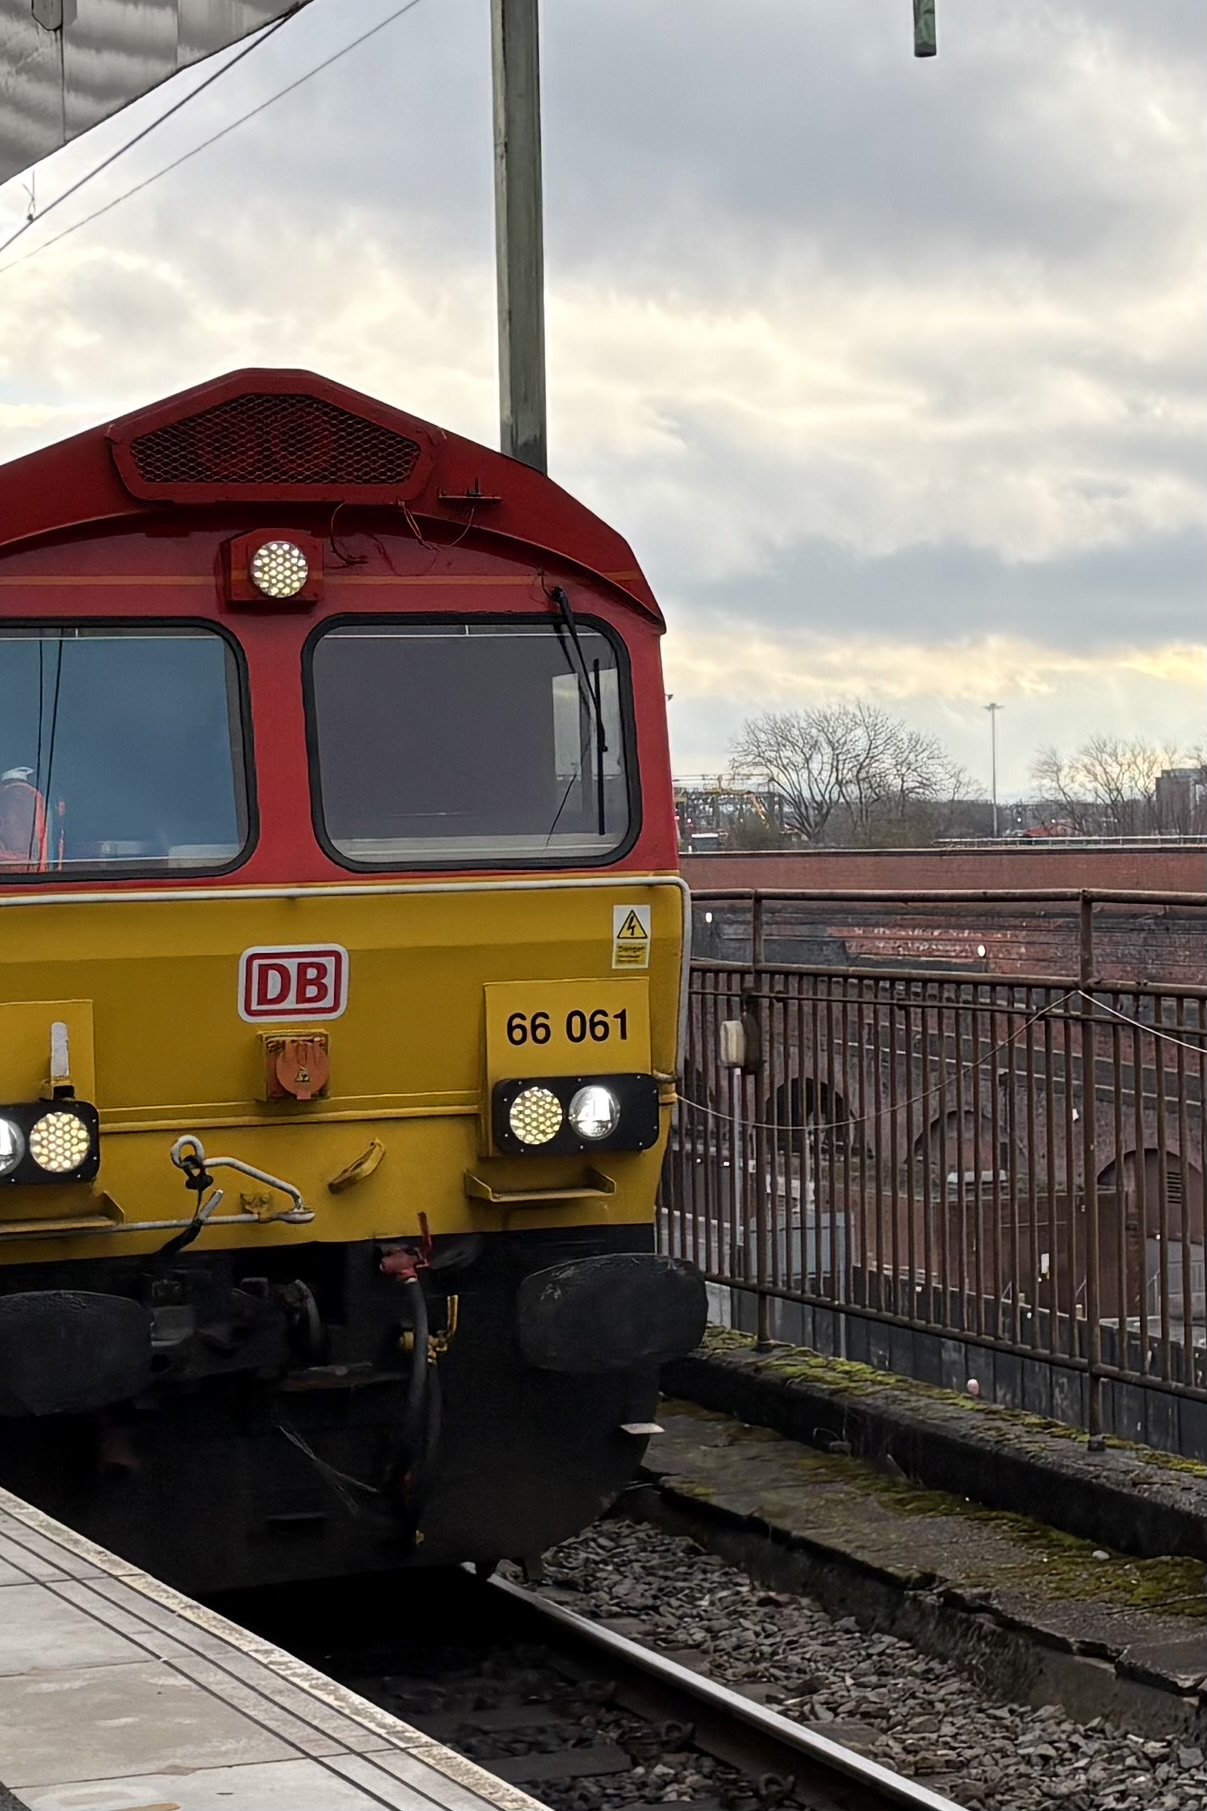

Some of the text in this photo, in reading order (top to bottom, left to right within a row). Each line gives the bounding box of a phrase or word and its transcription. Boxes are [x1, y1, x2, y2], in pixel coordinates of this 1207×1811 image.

[256, 961, 329, 1006] DB
[506, 1008, 628, 1046] 66 061
